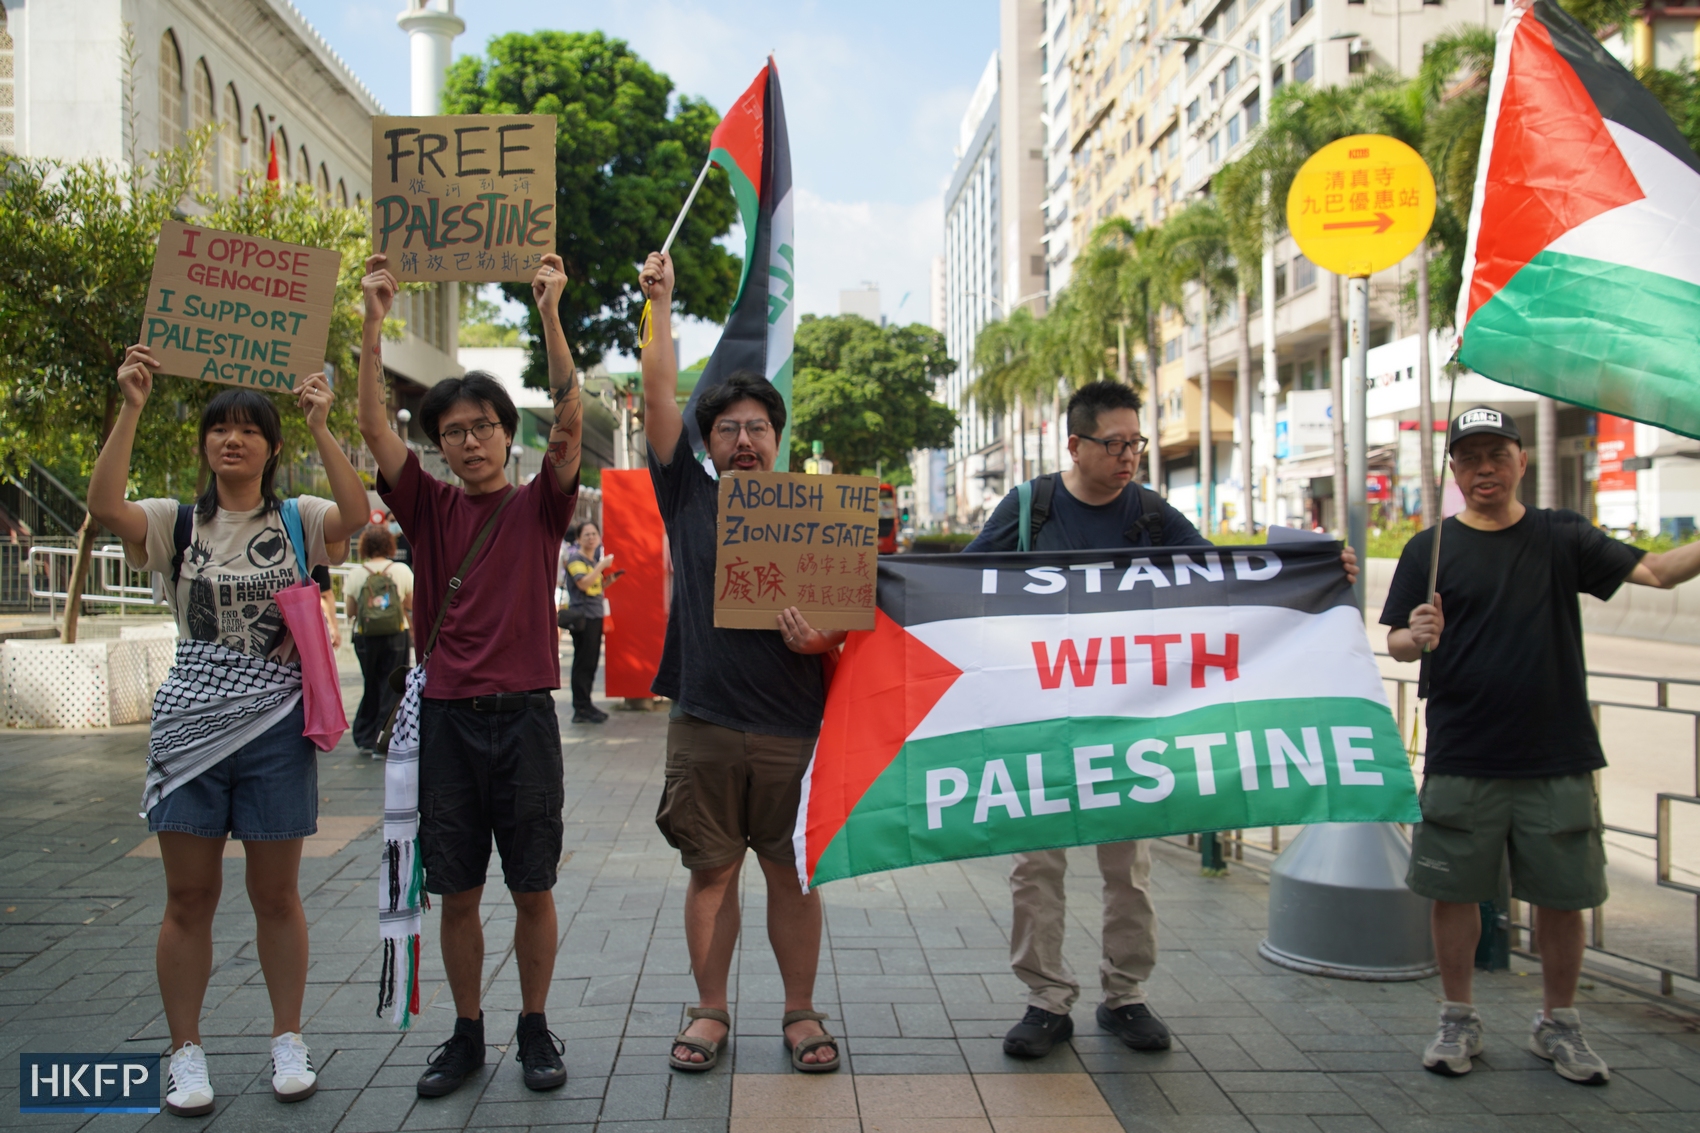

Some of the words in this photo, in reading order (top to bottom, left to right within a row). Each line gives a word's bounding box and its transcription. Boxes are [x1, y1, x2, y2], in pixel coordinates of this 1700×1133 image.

[384, 124, 535, 183] FREE
[1325, 167, 1395, 191] 清真寺
[1301, 187, 1420, 215] 九巴優惠站
[375, 192, 554, 253] PALESTINE
[178, 229, 201, 258] I
[207, 238, 310, 277] OPPOSE
[400, 251, 543, 277] 解放巴勒斯坦
[187, 263, 307, 303] GENOCIDE
[157, 288, 175, 313] I
[146, 318, 291, 367] PALESTINE
[200, 358, 297, 391] ACTION
[727, 478, 824, 512] ABOLISH
[836, 484, 878, 513] THE
[723, 515, 820, 546] ZIONIST
[822, 523, 876, 547] STATE
[217, 568, 294, 582] IRREGULAR
[719, 556, 787, 604] 廢除
[796, 551, 870, 579] 錫安主義
[981, 568, 998, 594] I
[1022, 550, 1283, 595] STAND
[236, 578, 295, 592] RHYTHM
[236, 589, 279, 602] ASYL
[797, 583, 874, 609] 殖民政權
[1031, 633, 1240, 690] WITH
[925, 725, 1385, 830] PALESTINE
